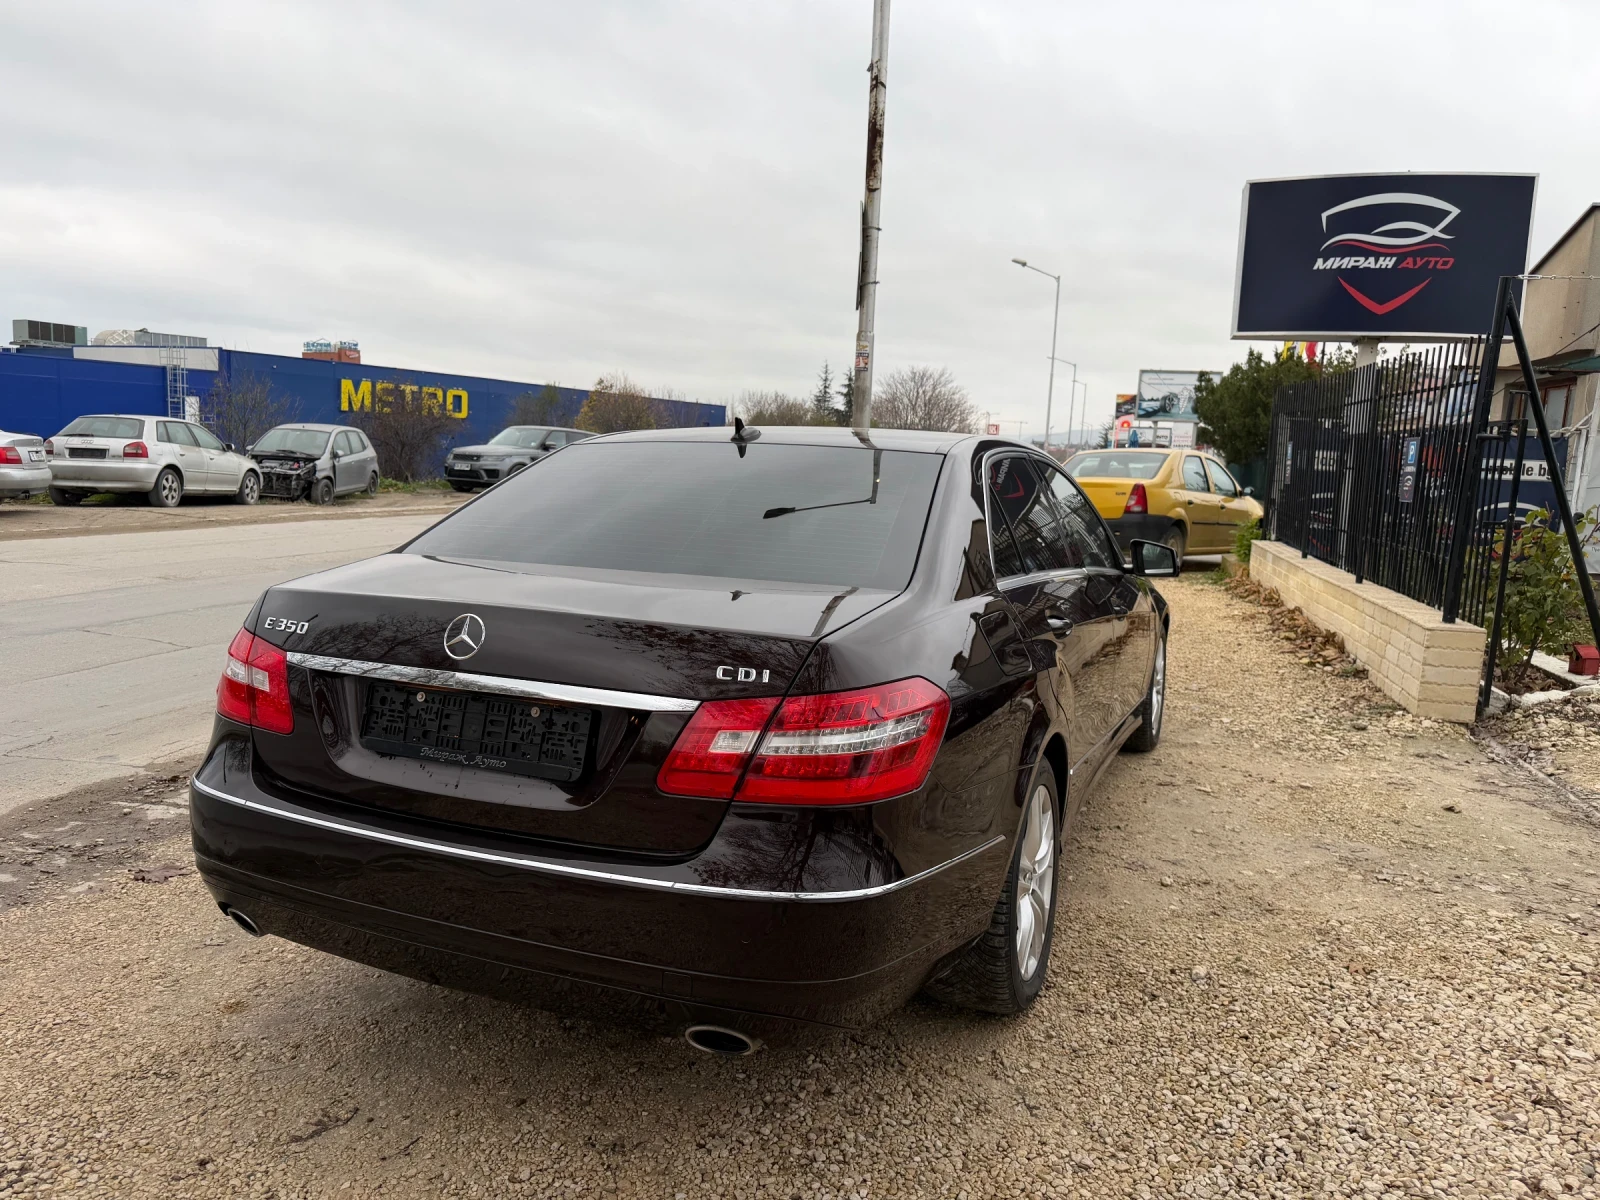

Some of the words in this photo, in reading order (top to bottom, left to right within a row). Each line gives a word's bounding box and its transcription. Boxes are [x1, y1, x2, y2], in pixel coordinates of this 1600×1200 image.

[1312, 256, 1397, 271] МИРАЖ
[1397, 257, 1455, 270] АУТО
[340, 378, 469, 419] METRO
[716, 665, 770, 683] CDI
[419, 747, 469, 765] Мираж
[469, 755, 507, 768] Ауто
